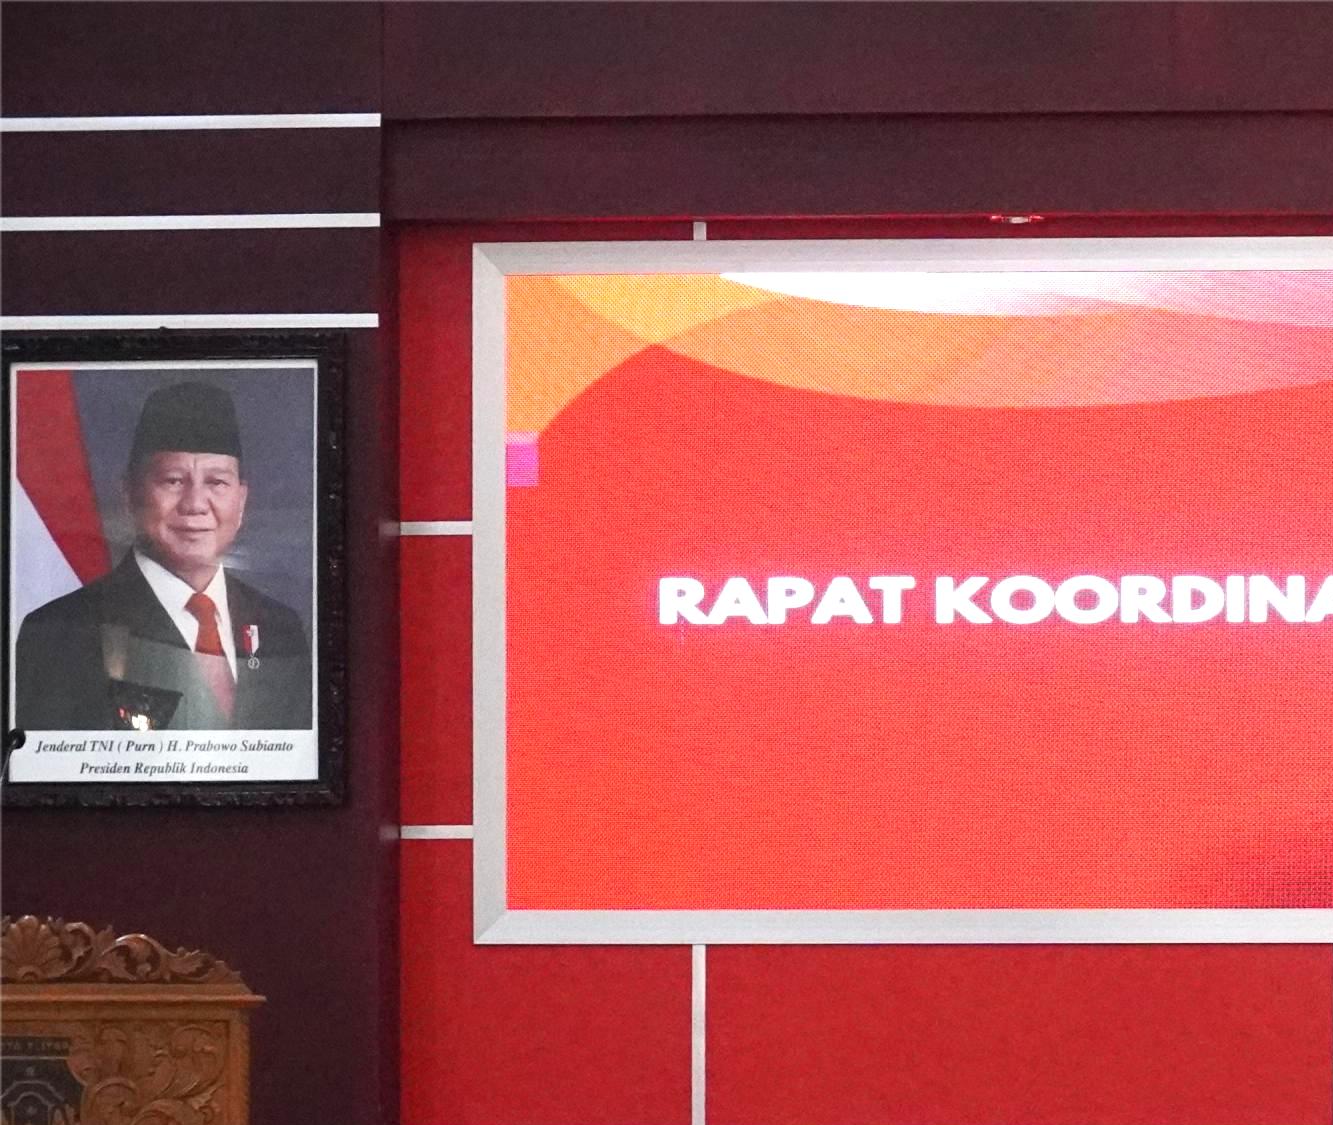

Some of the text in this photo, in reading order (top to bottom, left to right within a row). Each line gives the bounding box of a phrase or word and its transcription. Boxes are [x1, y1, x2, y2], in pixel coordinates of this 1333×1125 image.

[658, 575, 917, 626] RAPAT
[34, 740, 87, 753] Jenderal
[90, 740, 114, 752] TNI
[185, 740, 237, 752] Prabowo
[240, 740, 293, 752] Subianto
[80, 762, 249, 777] Presiden Republik Indonesia
